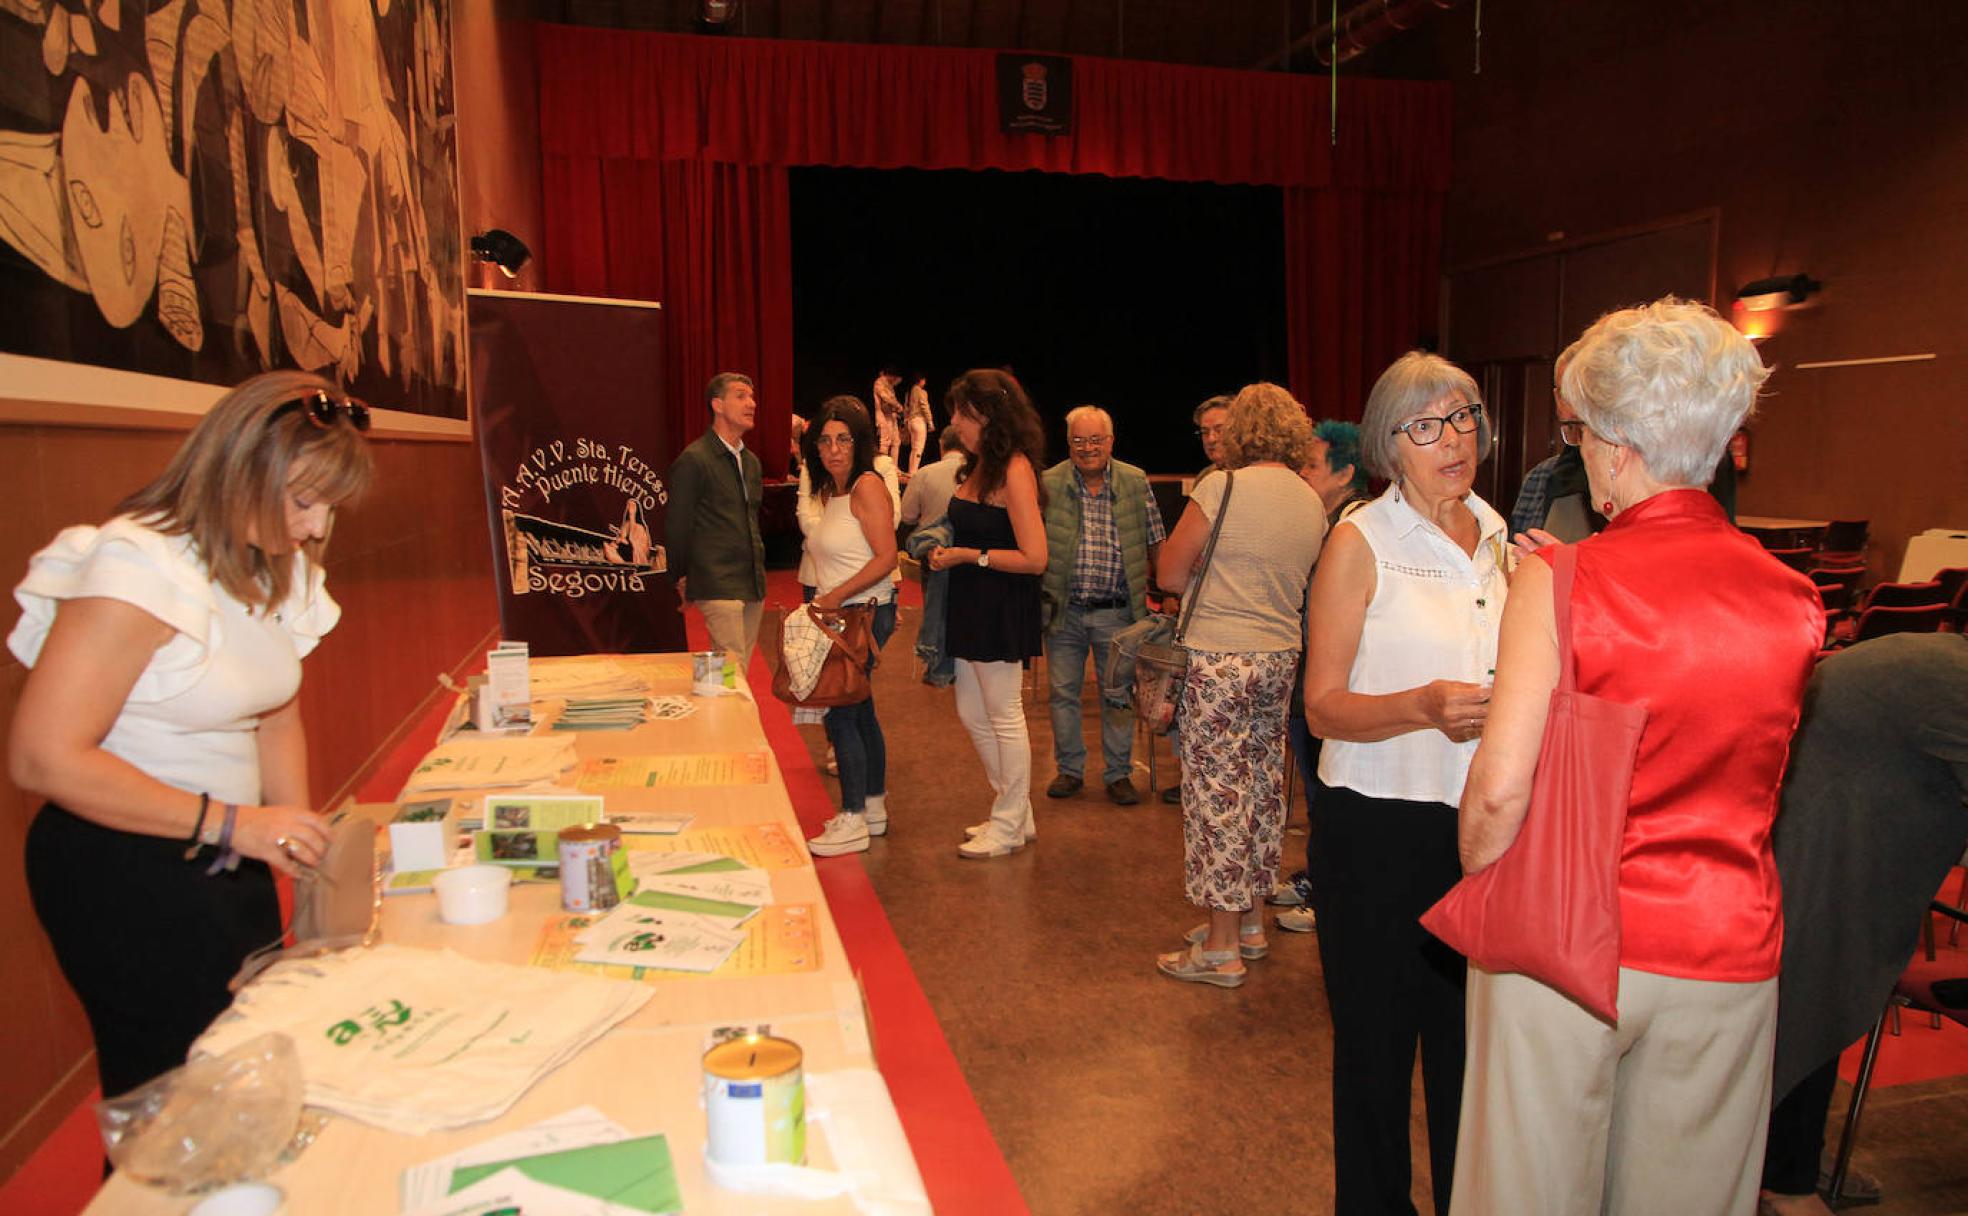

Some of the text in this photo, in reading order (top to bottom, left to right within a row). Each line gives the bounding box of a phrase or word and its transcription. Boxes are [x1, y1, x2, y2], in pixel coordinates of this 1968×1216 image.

[535, 462, 656, 511] Puente Hierro
[576, 437, 611, 461] Sta.
[619, 445, 668, 505] Teresa
[529, 566, 646, 598] Segovia
